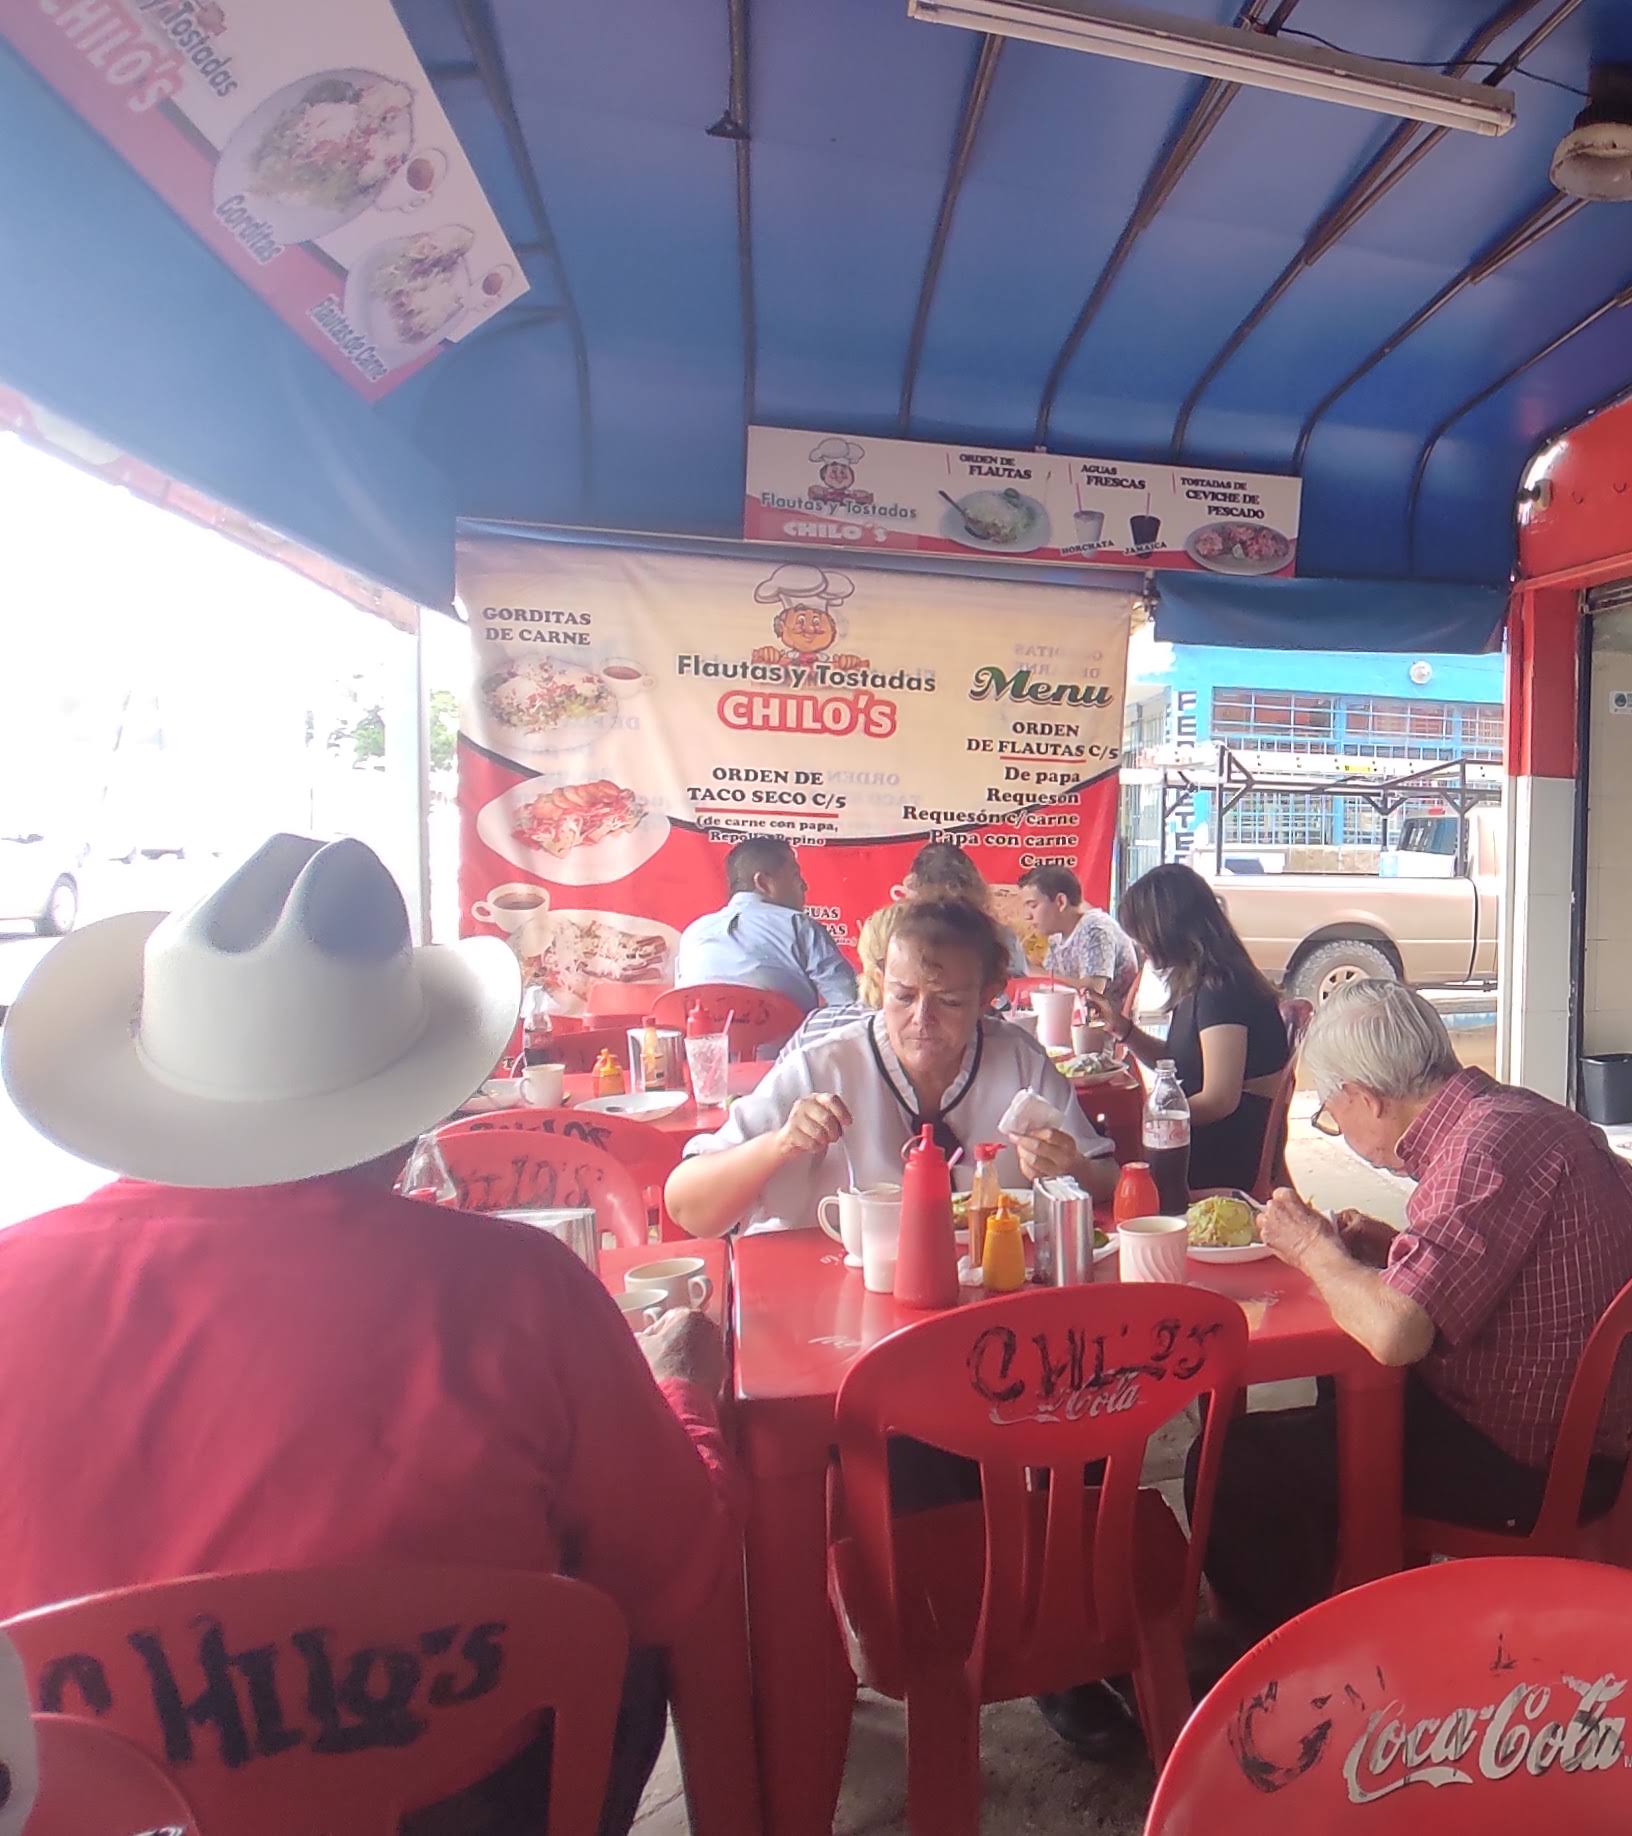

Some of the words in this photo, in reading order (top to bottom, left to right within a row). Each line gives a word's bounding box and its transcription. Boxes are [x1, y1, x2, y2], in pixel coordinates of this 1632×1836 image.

[217, 195, 283, 262] Gorditas
[309, 296, 353, 343] Flautas
[343, 335, 366, 354] de
[354, 346, 387, 380] Carne
[959, 453, 997, 465] ORDEN
[1000, 456, 1015, 466] DE
[969, 465, 1032, 480] FLAUTAS
[1081, 464, 1117, 475] AGUAS
[1086, 475, 1146, 490] FRESCAS
[1180, 477, 1232, 490] TOSTADAS
[1234, 482, 1247, 491] DE
[761, 492, 824, 512] Flautas
[829, 501, 838, 514] y
[845, 501, 917, 519] Tostadas
[1186, 490, 1240, 504] CEVICHE
[1242, 493, 1260, 505] DE
[1208, 506, 1265, 519] PESCADO
[1061, 539, 1115, 556] HORCHATA
[482, 607, 592, 626] GORDITAS
[485, 627, 514, 641] DE
[518, 629, 591, 646] CARNE
[677, 655, 782, 683] Flautas
[791, 668, 806, 689] y
[816, 664, 937, 693] Tostadas
[969, 666, 1113, 708] Menu
[720, 693, 894, 737] CHILO'S
[1012, 721, 1080, 737] ORDEN
[966, 738, 994, 752] DE
[998, 740, 1086, 757] FLAUTAS
[1088, 744, 1119, 761] C/5
[712, 767, 789, 784] ORDEN
[795, 771, 824, 786] DE
[1004, 766, 1031, 781] De
[1035, 770, 1081, 786] papa
[687, 787, 746, 802] TACO
[751, 790, 807, 806] SECO
[812, 793, 847, 810] C/5
[986, 788, 1079, 806] Requeson
[696, 815, 721, 827] (de
[724, 818, 766, 829] carne
[769, 821, 796, 830] con
[799, 821, 839, 833] papa,
[902, 805, 1001, 824] Requesón
[931, 830, 979, 847] Papa
[984, 836, 1019, 846] con
[1025, 835, 1078, 847] carne
[1020, 855, 1076, 867] Carne
